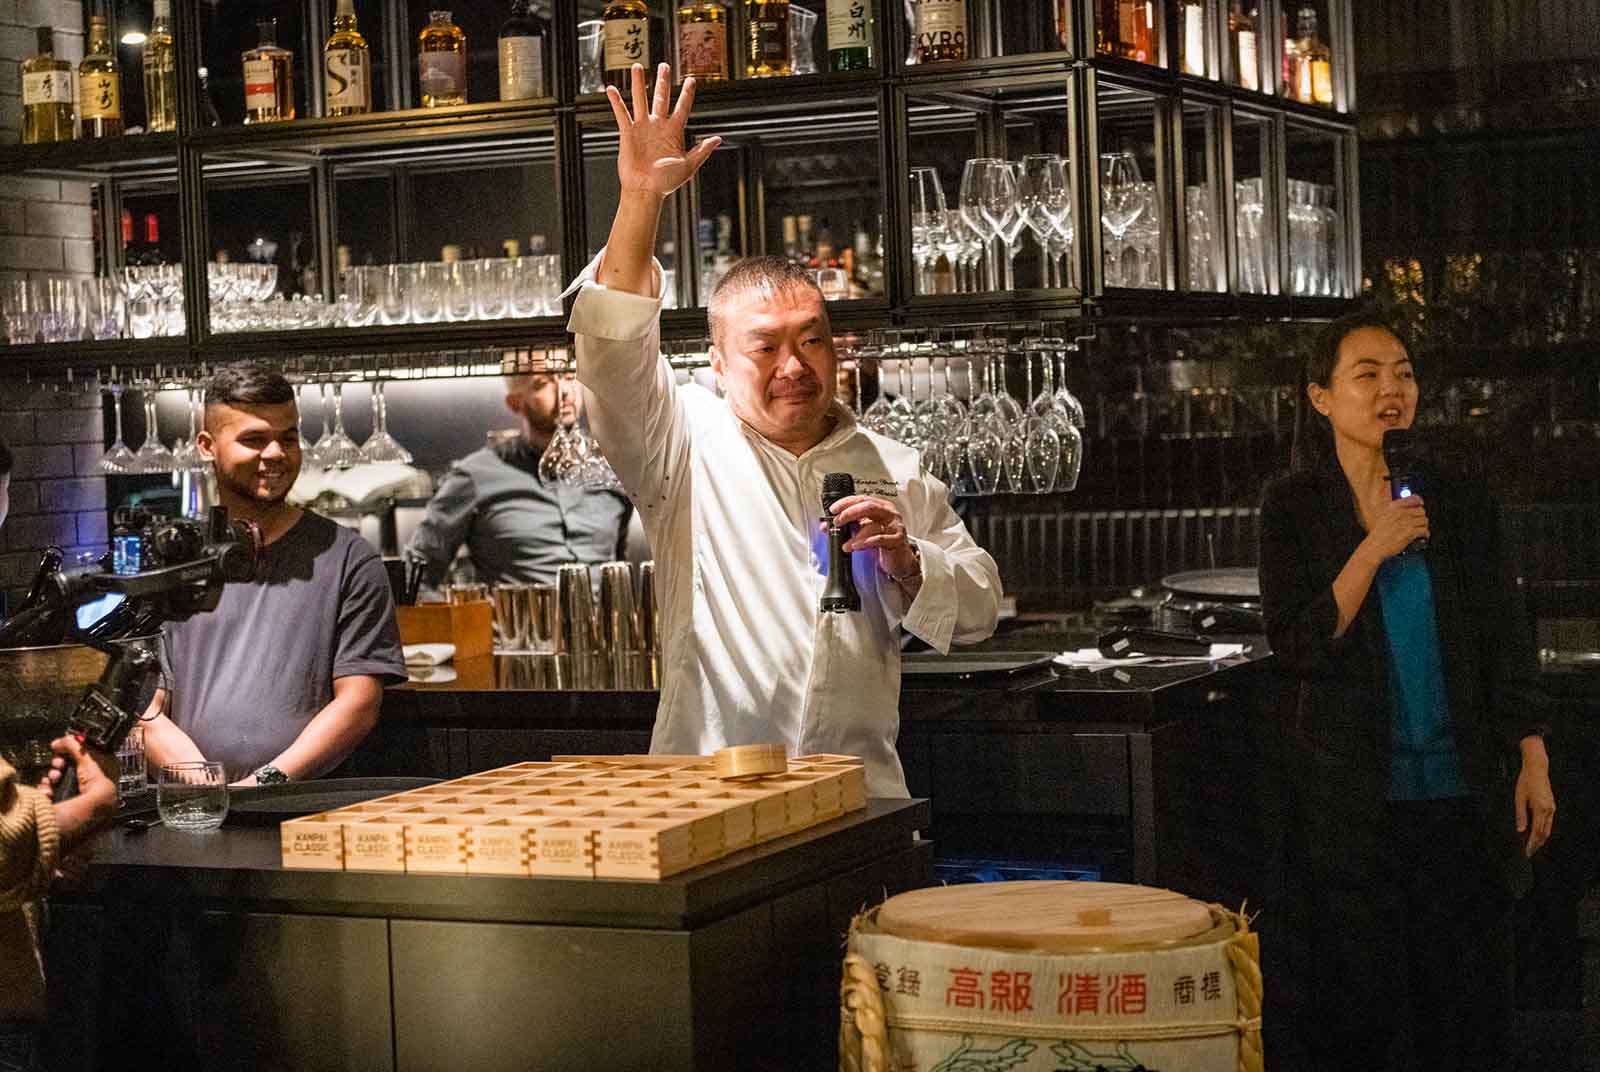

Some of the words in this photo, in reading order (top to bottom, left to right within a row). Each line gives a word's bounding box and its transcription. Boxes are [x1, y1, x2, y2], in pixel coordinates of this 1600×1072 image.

[848, 1, 866, 40] 白州
[296, 833, 327, 842] KANPAI
[294, 843, 330, 852] CLASSIC
